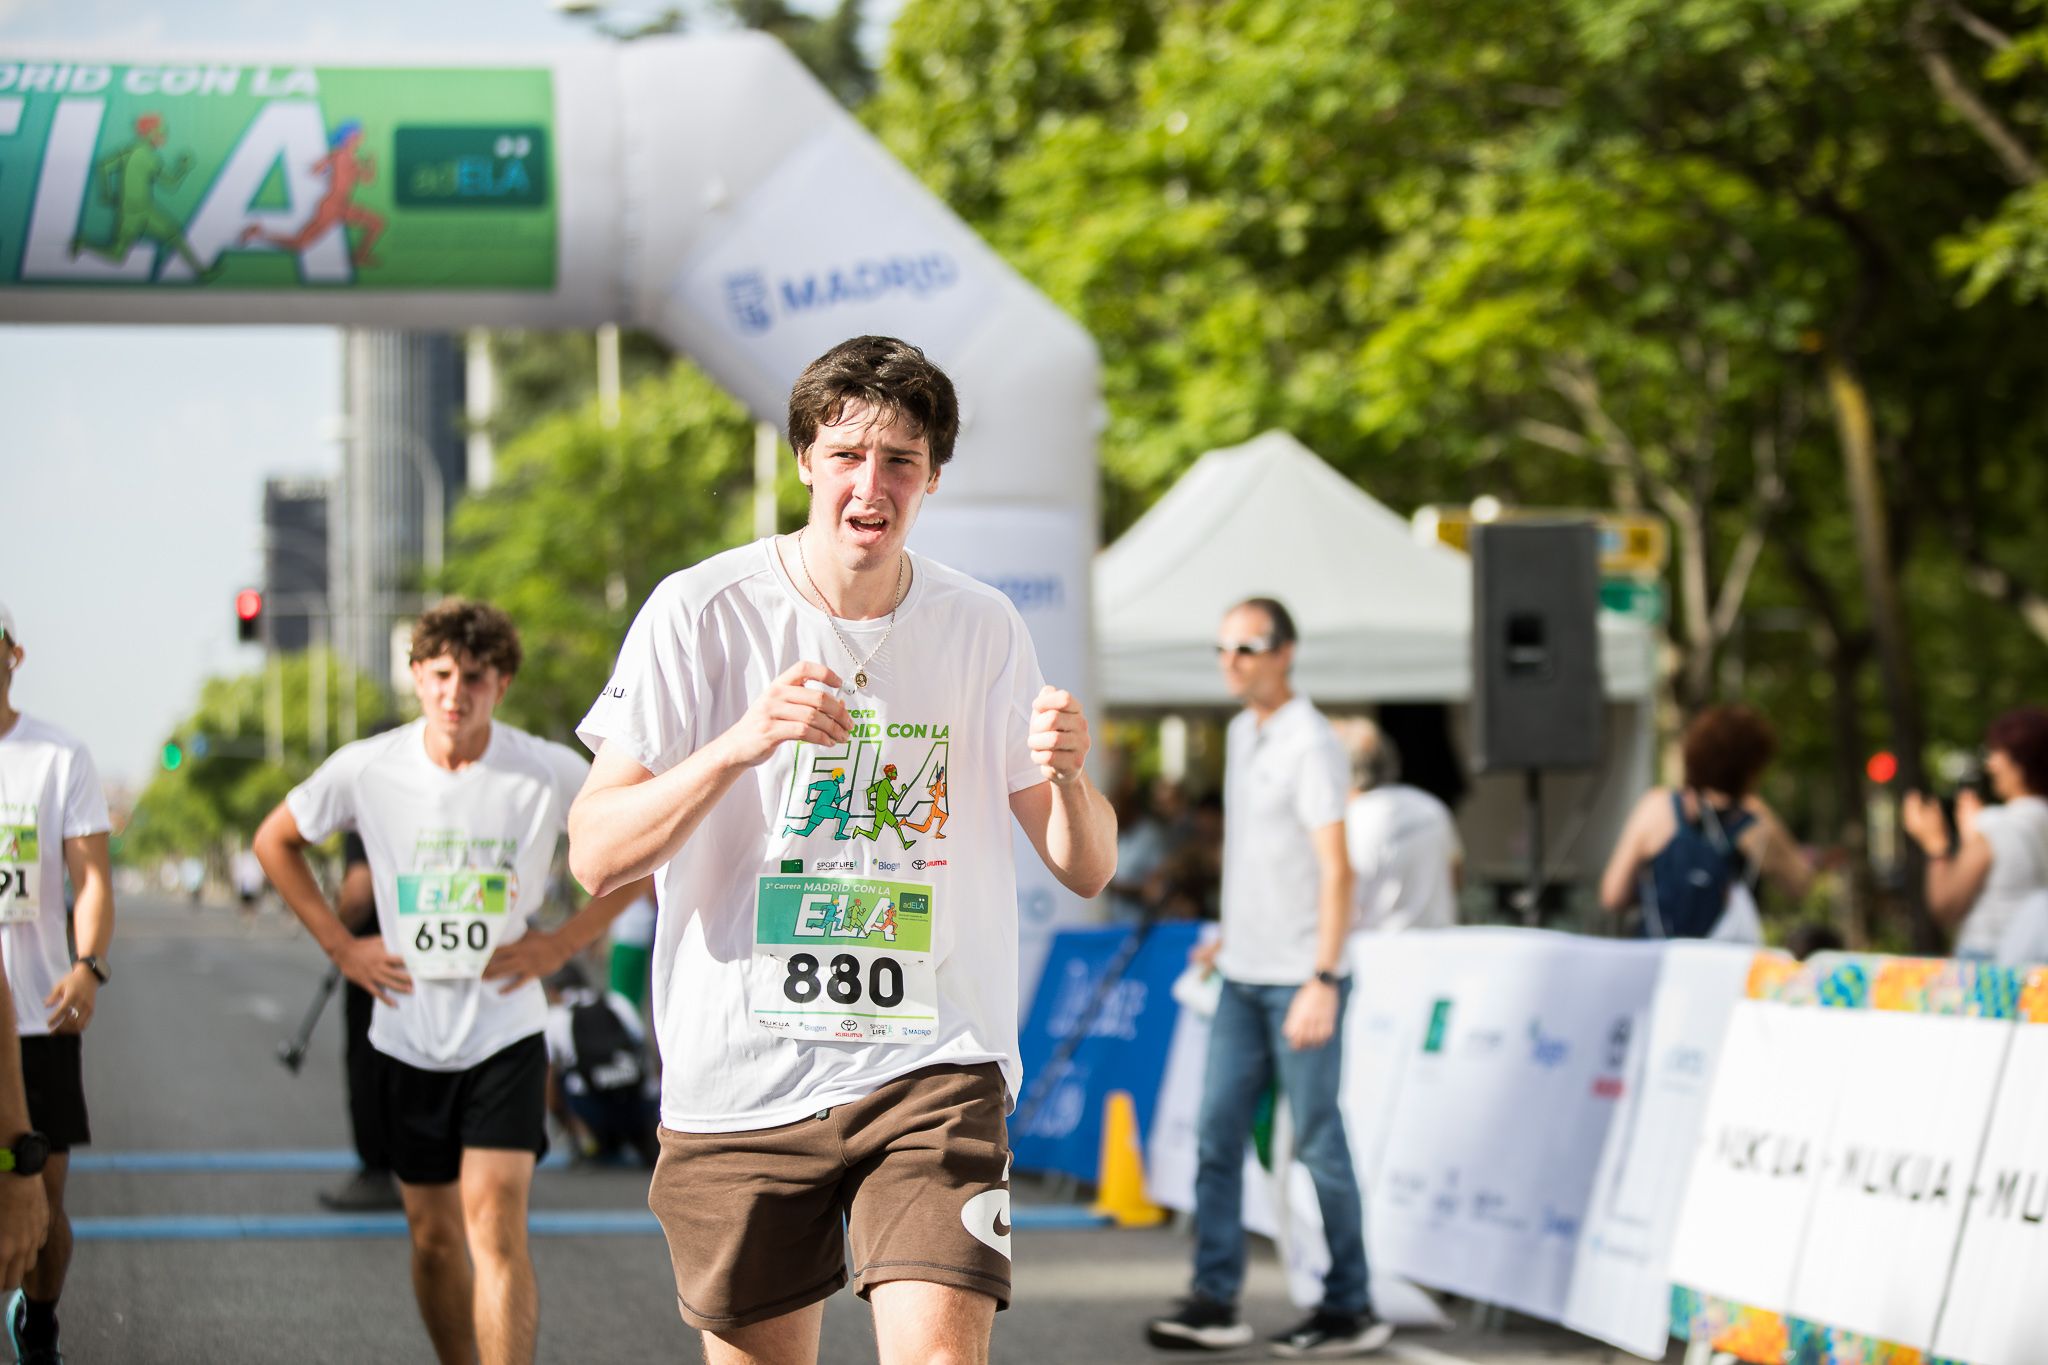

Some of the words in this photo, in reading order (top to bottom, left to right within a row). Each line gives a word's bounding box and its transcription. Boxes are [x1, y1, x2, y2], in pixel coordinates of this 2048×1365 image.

[122, 62, 241, 96] CON
[250, 64, 319, 97] LA
[778, 250, 958, 310] MADRID
[886, 723, 928, 739] CON
[931, 724, 949, 739] LA
[784, 740, 950, 819] ELA
[416, 876, 485, 913] ELA
[804, 882, 851, 893] MADRID
[853, 884, 877, 894] CON
[878, 886, 891, 896] LA
[903, 901, 925, 910] adELA
[792, 893, 897, 942] ELA
[415, 920, 489, 951] 650
[783, 952, 905, 1008] 880
[759, 1019, 790, 1027] MUKUA
[908, 1028, 932, 1037] MADRID
